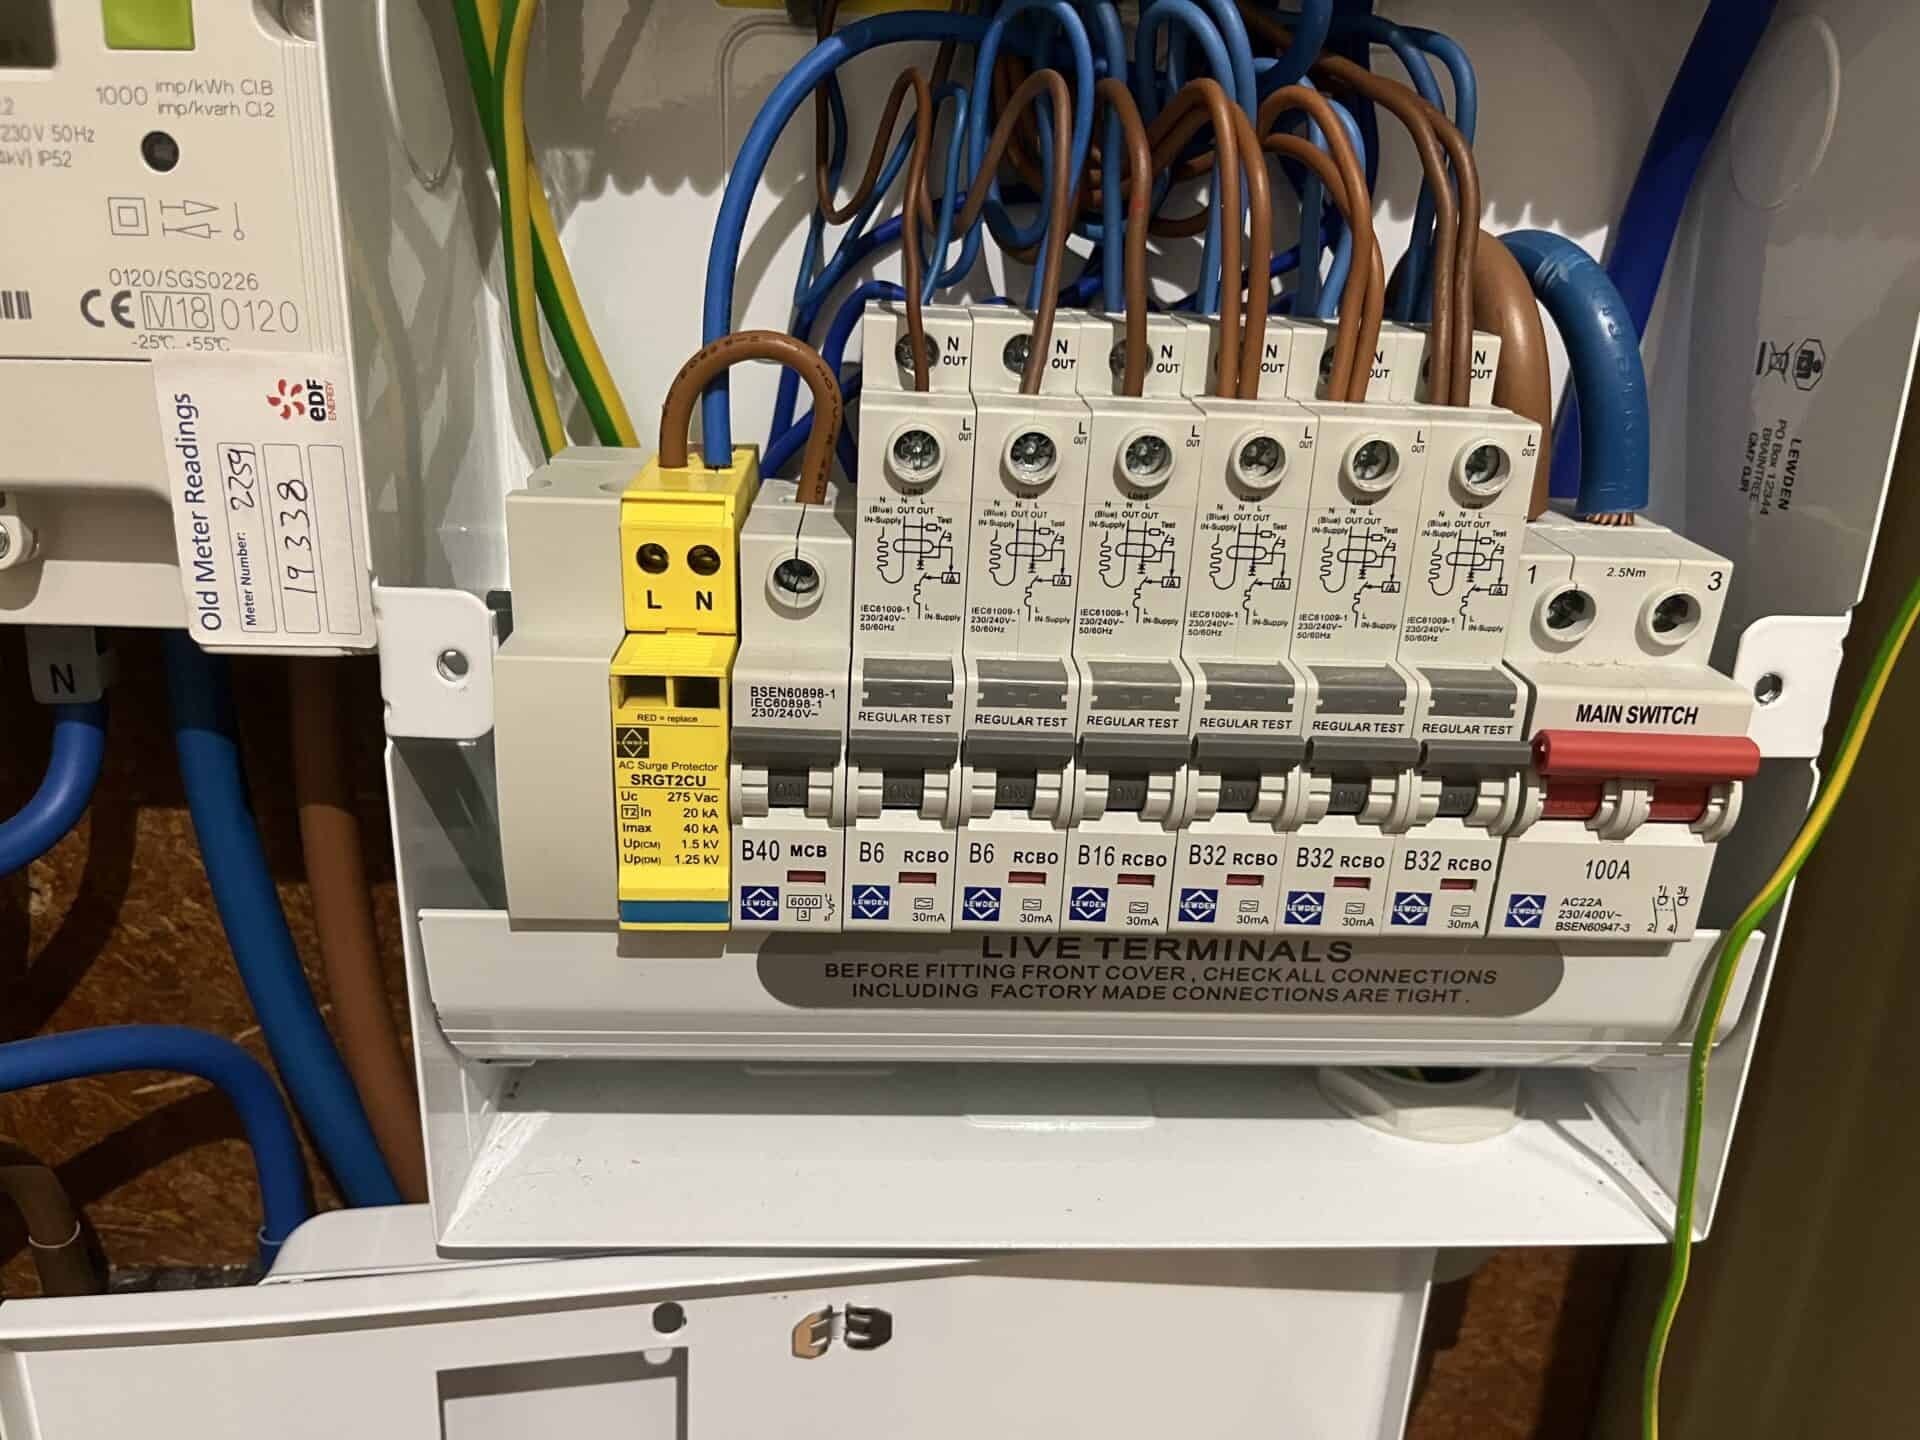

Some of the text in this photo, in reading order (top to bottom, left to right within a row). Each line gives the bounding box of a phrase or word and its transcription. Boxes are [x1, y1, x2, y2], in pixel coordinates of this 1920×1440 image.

[155, 79, 235, 97] imp/kWh
[95, 86, 148, 106] 1000
[157, 102, 240, 119] imp/kvarh
[109, 268, 259, 290] 0120/SGS0226
[80, 289, 298, 333] CE M18 0120
[947, 336, 959, 351] N
[1056, 340, 1068, 354] N
[1161, 345, 1173, 358] N
[1265, 345, 1278, 358] N
[1474, 351, 1486, 364] N
[943, 356, 968, 366] OUT
[1051, 359, 1076, 369] OUT
[1156, 363, 1180, 374] OUT
[1260, 363, 1285, 374] OUT
[325, 381, 337, 421] ENERGY
[962, 418, 971, 431] L
[1078, 421, 1087, 435] L
[1191, 424, 1200, 437] L
[1304, 426, 1312, 439] L
[1416, 430, 1425, 444] L
[1527, 434, 1536, 447] L
[1778, 437, 1802, 511] LEWDEN
[174, 393, 222, 631] Old Meter Readings
[897, 506, 915, 514] OUT
[917, 506, 934, 515] OUT
[236, 532, 257, 626] Meter Number:
[1527, 564, 1722, 591] 1 2.5Nm 3
[647, 590, 713, 610] L N
[49, 663, 75, 693] N
[750, 686, 835, 699] BSEN60898-1
[751, 698, 822, 708] IEC60898-1
[637, 713, 657, 722] RED
[858, 712, 951, 725] REGULAR TEST
[975, 714, 1068, 728] REGULAR TEST
[1576, 704, 1699, 725] MAIN SWITCH
[1086, 715, 1179, 729] REGULAR TEST
[1199, 717, 1293, 730] REGULAR TEST
[1312, 721, 1404, 734] REGULAR TEST
[1422, 723, 1513, 736] REGULAR TEST
[618, 761, 719, 772] AC Surge Protector
[631, 774, 706, 787] SRGT2CU
[667, 792, 691, 802] 275
[694, 793, 719, 803] Vac
[623, 807, 638, 817] T2
[683, 808, 699, 818] 20
[702, 808, 719, 818] kA
[683, 823, 699, 834] 40
[702, 824, 719, 834] kA
[681, 839, 699, 849] 1.5
[702, 839, 719, 849] kV
[741, 839, 827, 861] B40 MCB
[859, 841, 949, 863] B6 RCBO
[969, 842, 1058, 864] B6 RCBO
[1078, 844, 1167, 867] B16 RCBO
[1189, 844, 1278, 866] B32 RCBO
[1296, 847, 1385, 868] B32 RCBO
[674, 854, 700, 865] 1.25
[703, 855, 719, 865] kV
[1404, 850, 1492, 872] B32 RCBO
[1584, 859, 1631, 880] 100A
[741, 899, 778, 907] LEWDEN
[790, 897, 818, 906] 6000
[852, 899, 889, 907] LEWDEN
[964, 900, 1000, 908] LEWDEN
[1071, 900, 1106, 908] LEWDEN
[1180, 902, 1216, 910] LEWDEN
[1287, 904, 1322, 912] LEWDEN
[1560, 897, 1602, 908] AC22A
[800, 910, 808, 919] 3
[1394, 905, 1430, 914] LEWDEN
[1508, 907, 1543, 916] LEWDEN
[912, 912, 945, 922] 30mA
[1019, 913, 1053, 923] 30mA
[1125, 916, 1159, 926] 30mA
[1236, 915, 1269, 925] 30mA
[1342, 917, 1375, 927] 30mA
[1447, 919, 1479, 929] 30mA
[1555, 921, 1630, 933] BSEN60947-3
[982, 936, 1353, 962] LIVE TERMINALS
[824, 963, 918, 978] BEFORE
[926, 963, 1016, 979] FITTING
[1022, 964, 1100, 980] FRONT
[1203, 967, 1285, 982] CHECK
[1288, 967, 1325, 982] ALL
[1332, 968, 1497, 985] CONNECTIONS
[852, 983, 979, 998] INCLUDING
[991, 984, 1097, 1000] FACTORY
[1102, 984, 1165, 1000] MADE
[1172, 986, 1345, 1002] CONNECTIONS
[1346, 987, 1389, 1002] ARE
